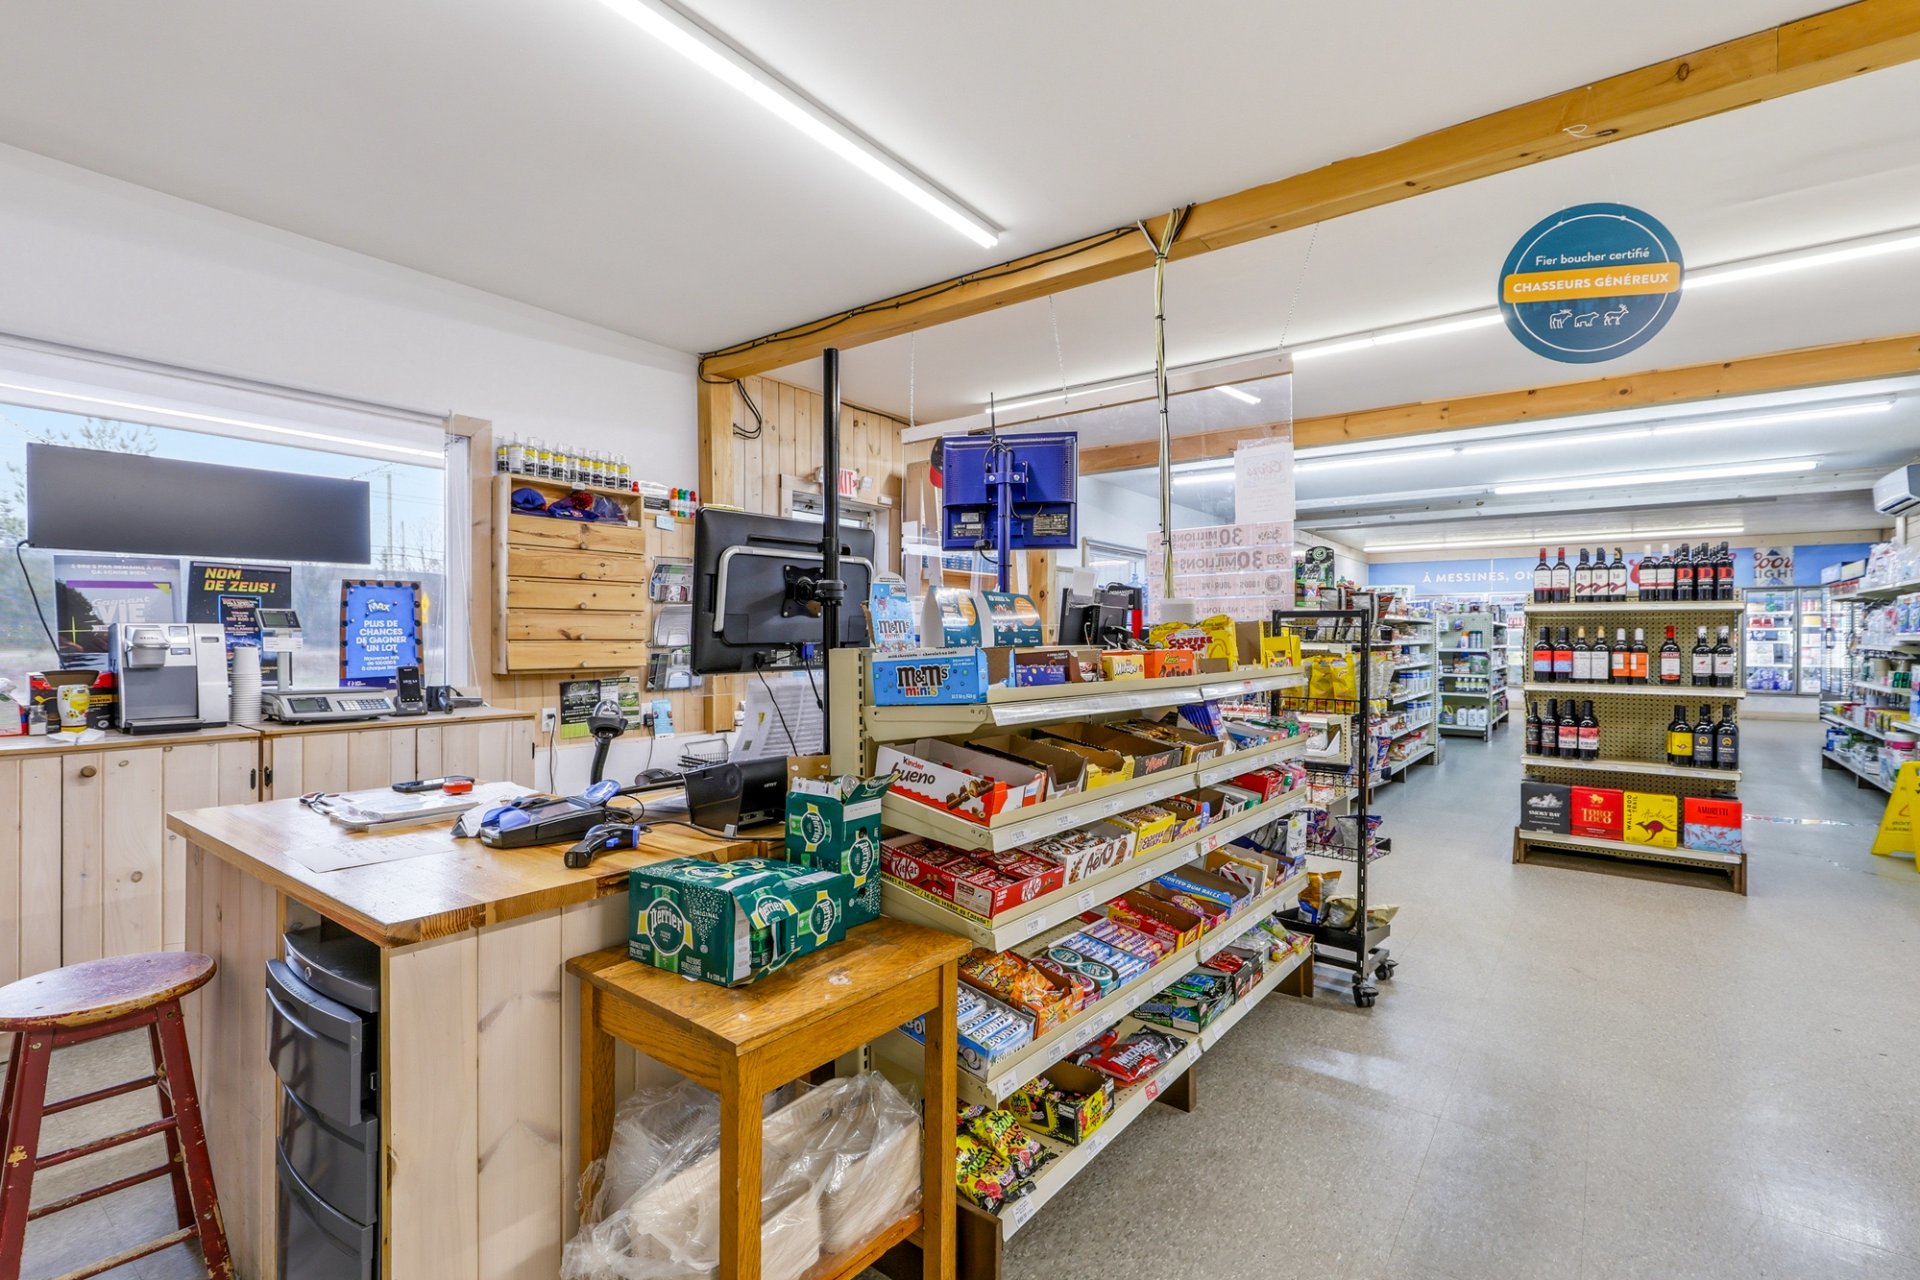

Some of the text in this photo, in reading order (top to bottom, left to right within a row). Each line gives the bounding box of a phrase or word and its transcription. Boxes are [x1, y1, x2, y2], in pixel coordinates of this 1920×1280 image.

[1535, 247, 1650, 266] Fier boucher certifié
[1513, 272, 1669, 293] CHASSEURS GÉNÉREUX
[204, 568, 242, 579] NOM
[1422, 571, 1432, 583] À
[1435, 571, 1510, 584] MESSINES,
[204, 580, 227, 591] DE
[98, 603, 146, 623] VIE
[364, 620, 385, 628] PLUS
[359, 628, 403, 636] CHANCES
[369, 636, 407, 644] GAGNER
[1168, 636, 1214, 645] COFFEE
[381, 644, 398, 652] LOT
[905, 687, 938, 697] minis
[891, 762, 936, 785] bueno
[1581, 807, 1614, 818] TORO
[1583, 815, 1612, 825] LOCO
[894, 859, 919, 878] KitKat
[650, 908, 683, 937] Perrier
[972, 1016, 1009, 1041] BOUNTY
[988, 1022, 1023, 1047] BOUNTY
